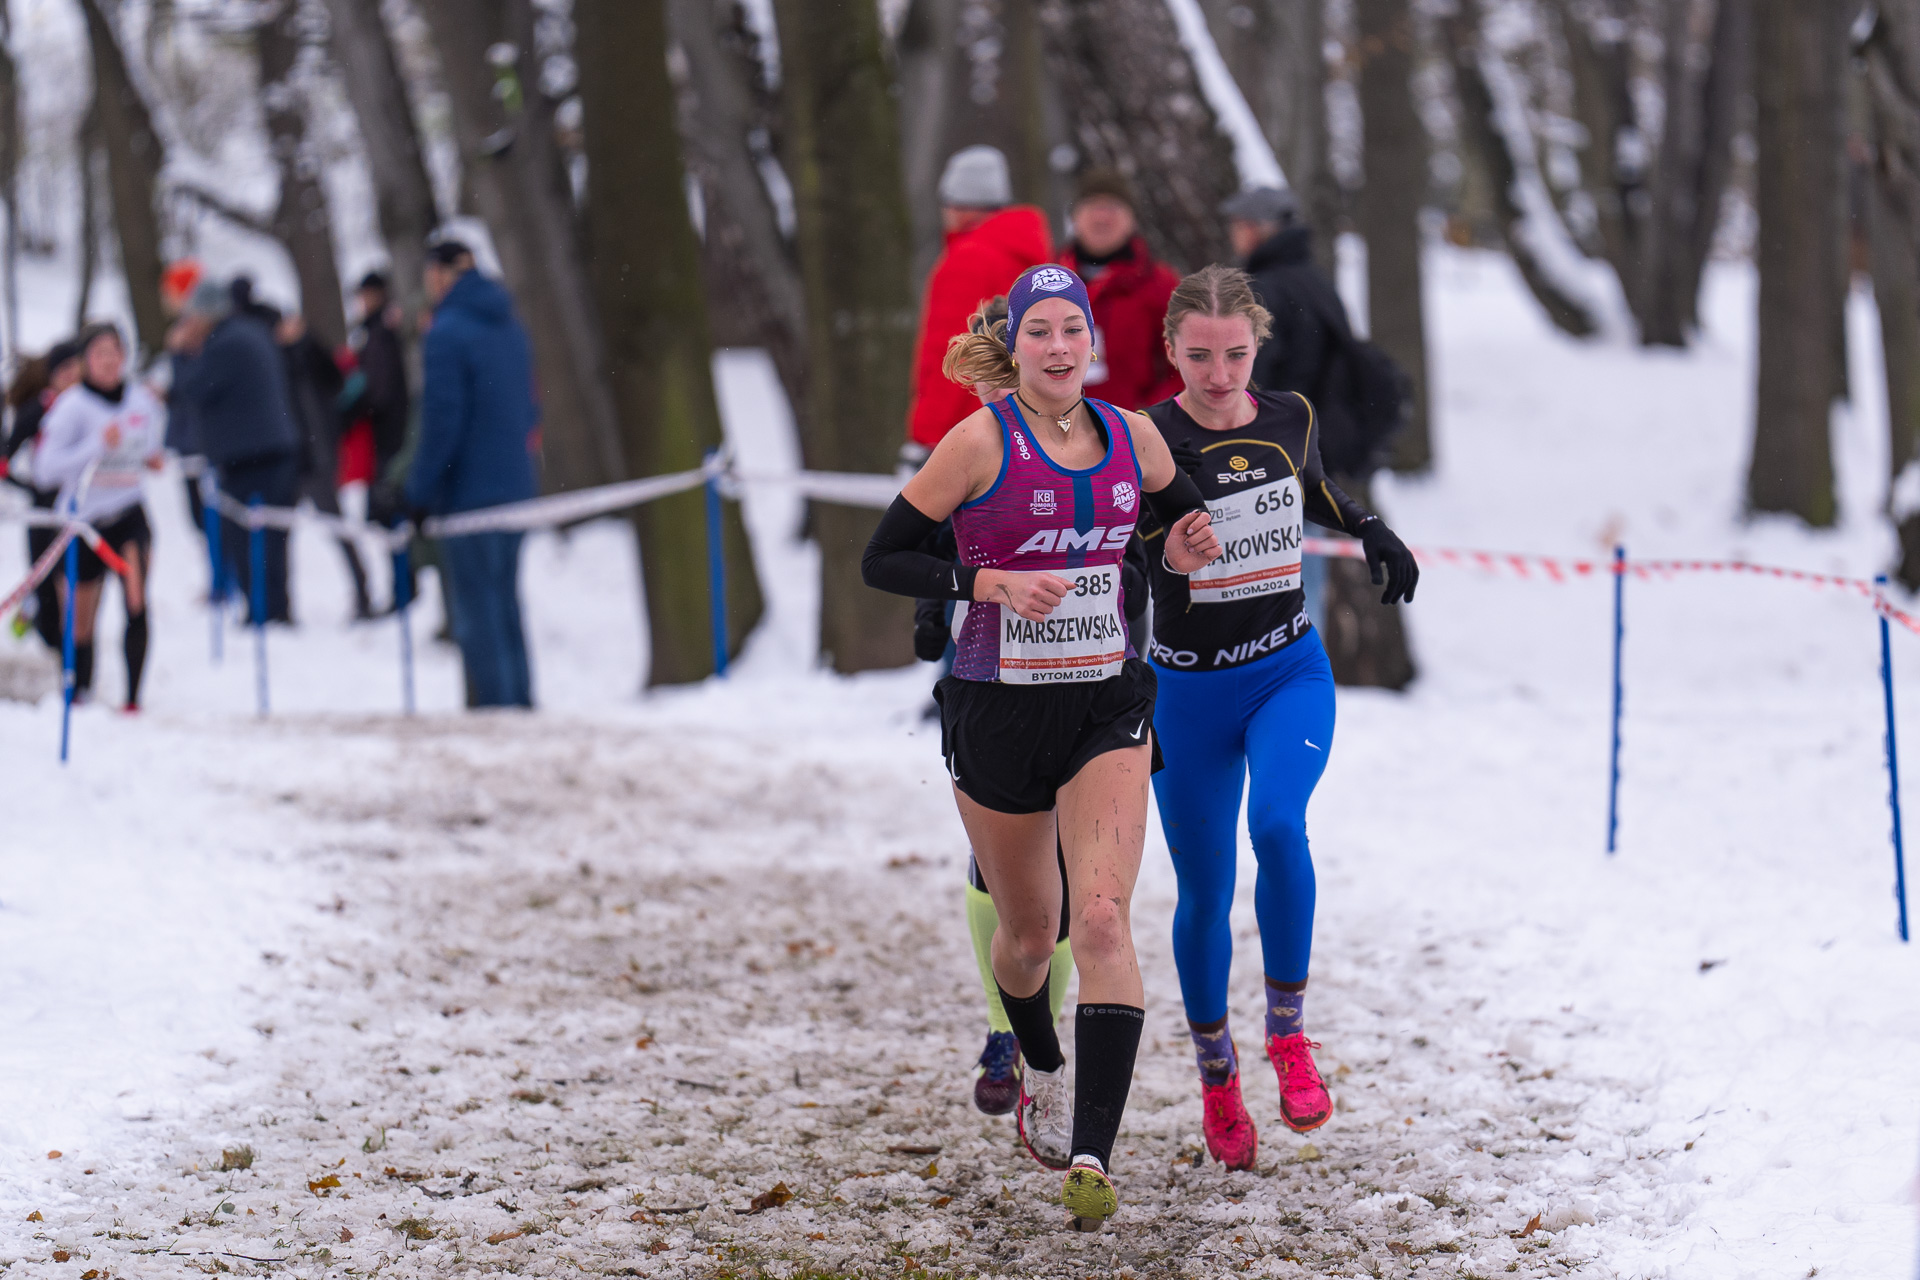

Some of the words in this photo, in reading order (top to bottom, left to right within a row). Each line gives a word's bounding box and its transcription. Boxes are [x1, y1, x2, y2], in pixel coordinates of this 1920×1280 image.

[1013, 431, 1031, 460] deep
[1037, 492, 1051, 503] KB
[1113, 490, 1136, 507] AMS
[1254, 486, 1294, 515] 656
[1014, 523, 1136, 555] AMS
[1074, 572, 1112, 597] 385
[1221, 584, 1260, 599] BYTOM
[1262, 579, 1291, 592] 2024
[1006, 613, 1122, 644] MARSZEWSKA
[1213, 623, 1288, 666] NIKE
[1031, 671, 1074, 682] BYTOM
[1075, 669, 1103, 679] 2024
